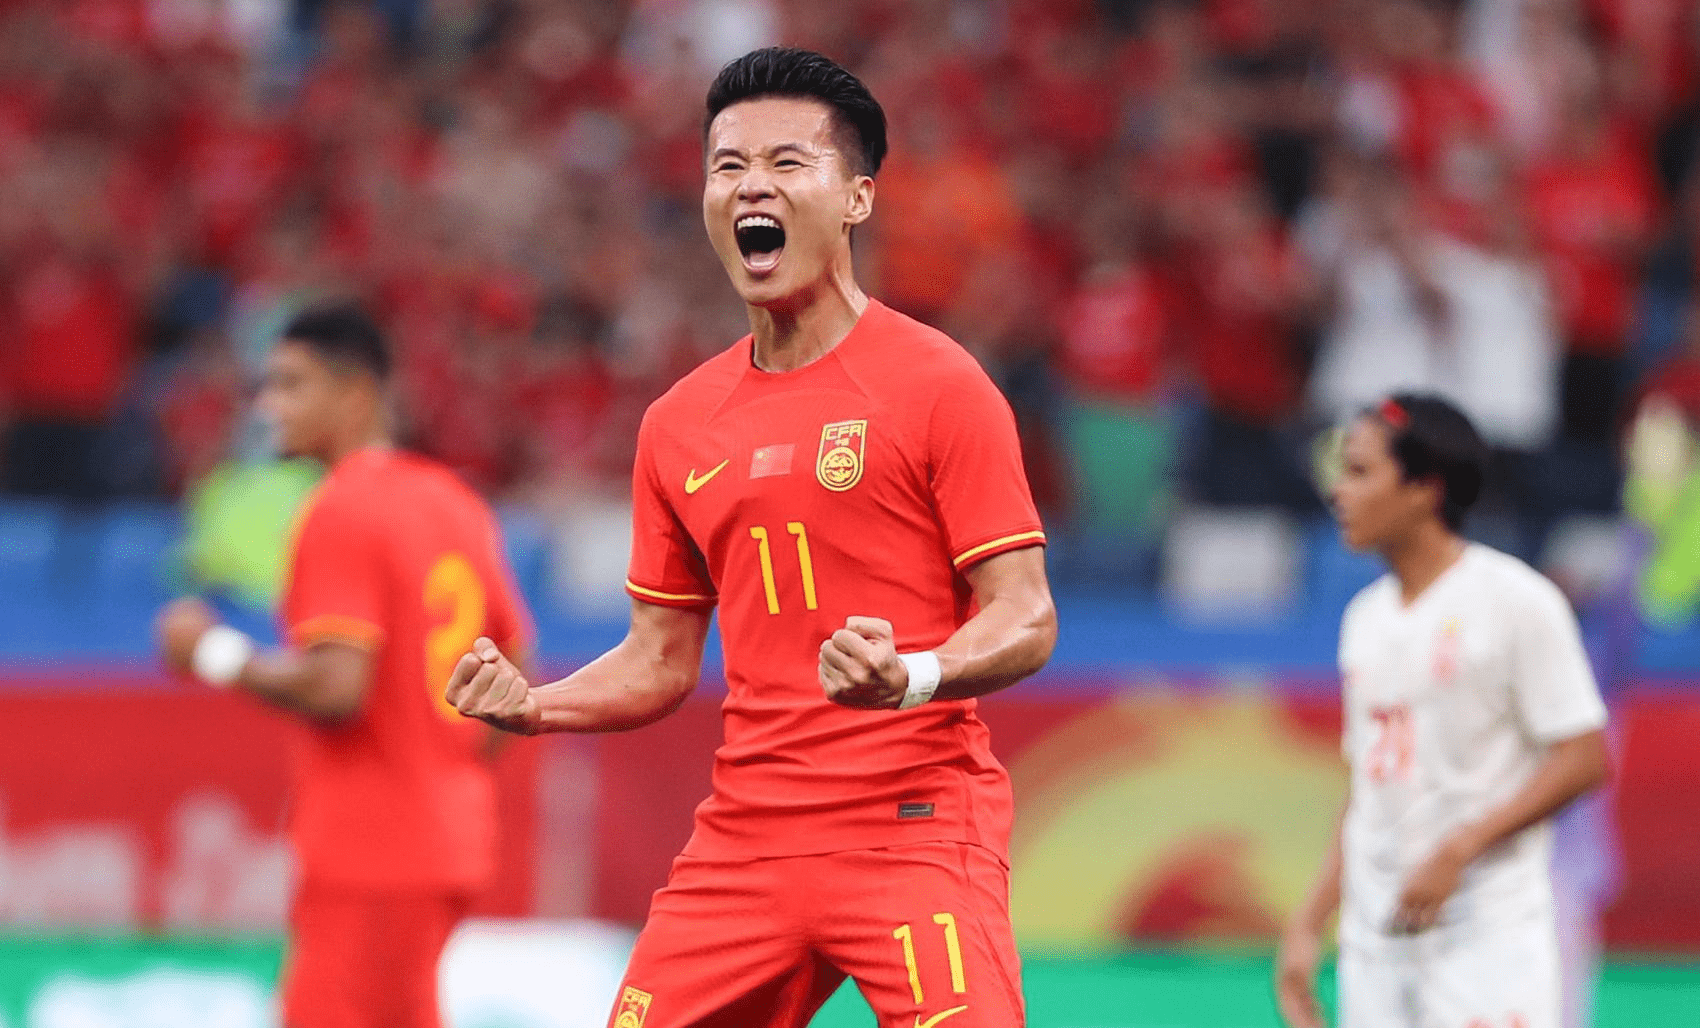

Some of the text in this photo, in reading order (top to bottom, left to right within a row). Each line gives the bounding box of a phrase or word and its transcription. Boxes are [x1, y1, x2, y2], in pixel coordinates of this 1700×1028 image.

[825, 424, 862, 440] CFA
[749, 521, 818, 615] 11
[424, 553, 487, 724] 2
[893, 912, 966, 1005] 11
